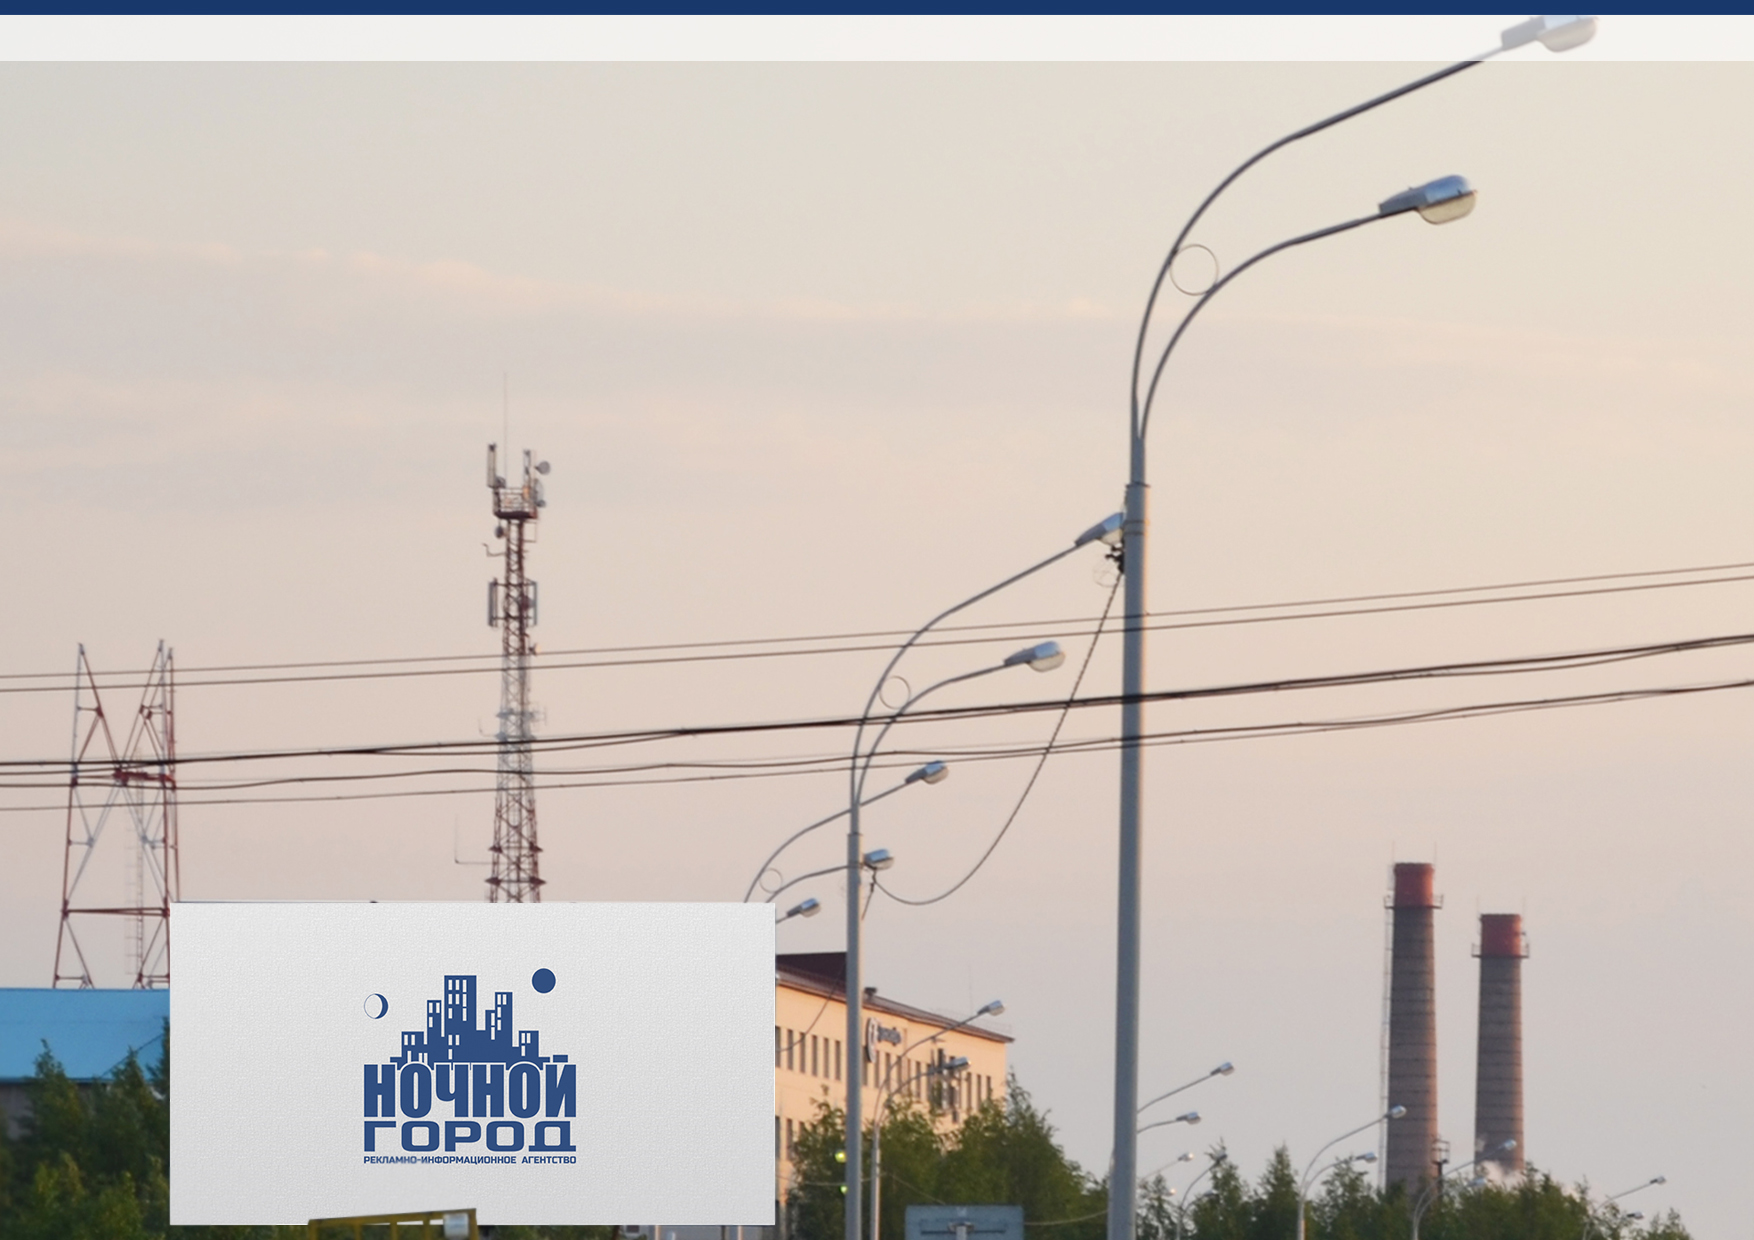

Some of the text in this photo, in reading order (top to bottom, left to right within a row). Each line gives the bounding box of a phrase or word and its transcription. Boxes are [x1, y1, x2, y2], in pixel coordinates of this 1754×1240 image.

[363, 1055, 577, 1118] НОЧНОЙ
[363, 1121, 577, 1152] ГОРОД
[363, 1155, 577, 1165] РЕКЛАМНО-ИНФОРМАЦИОННОЕ АГЕНТСТВО
